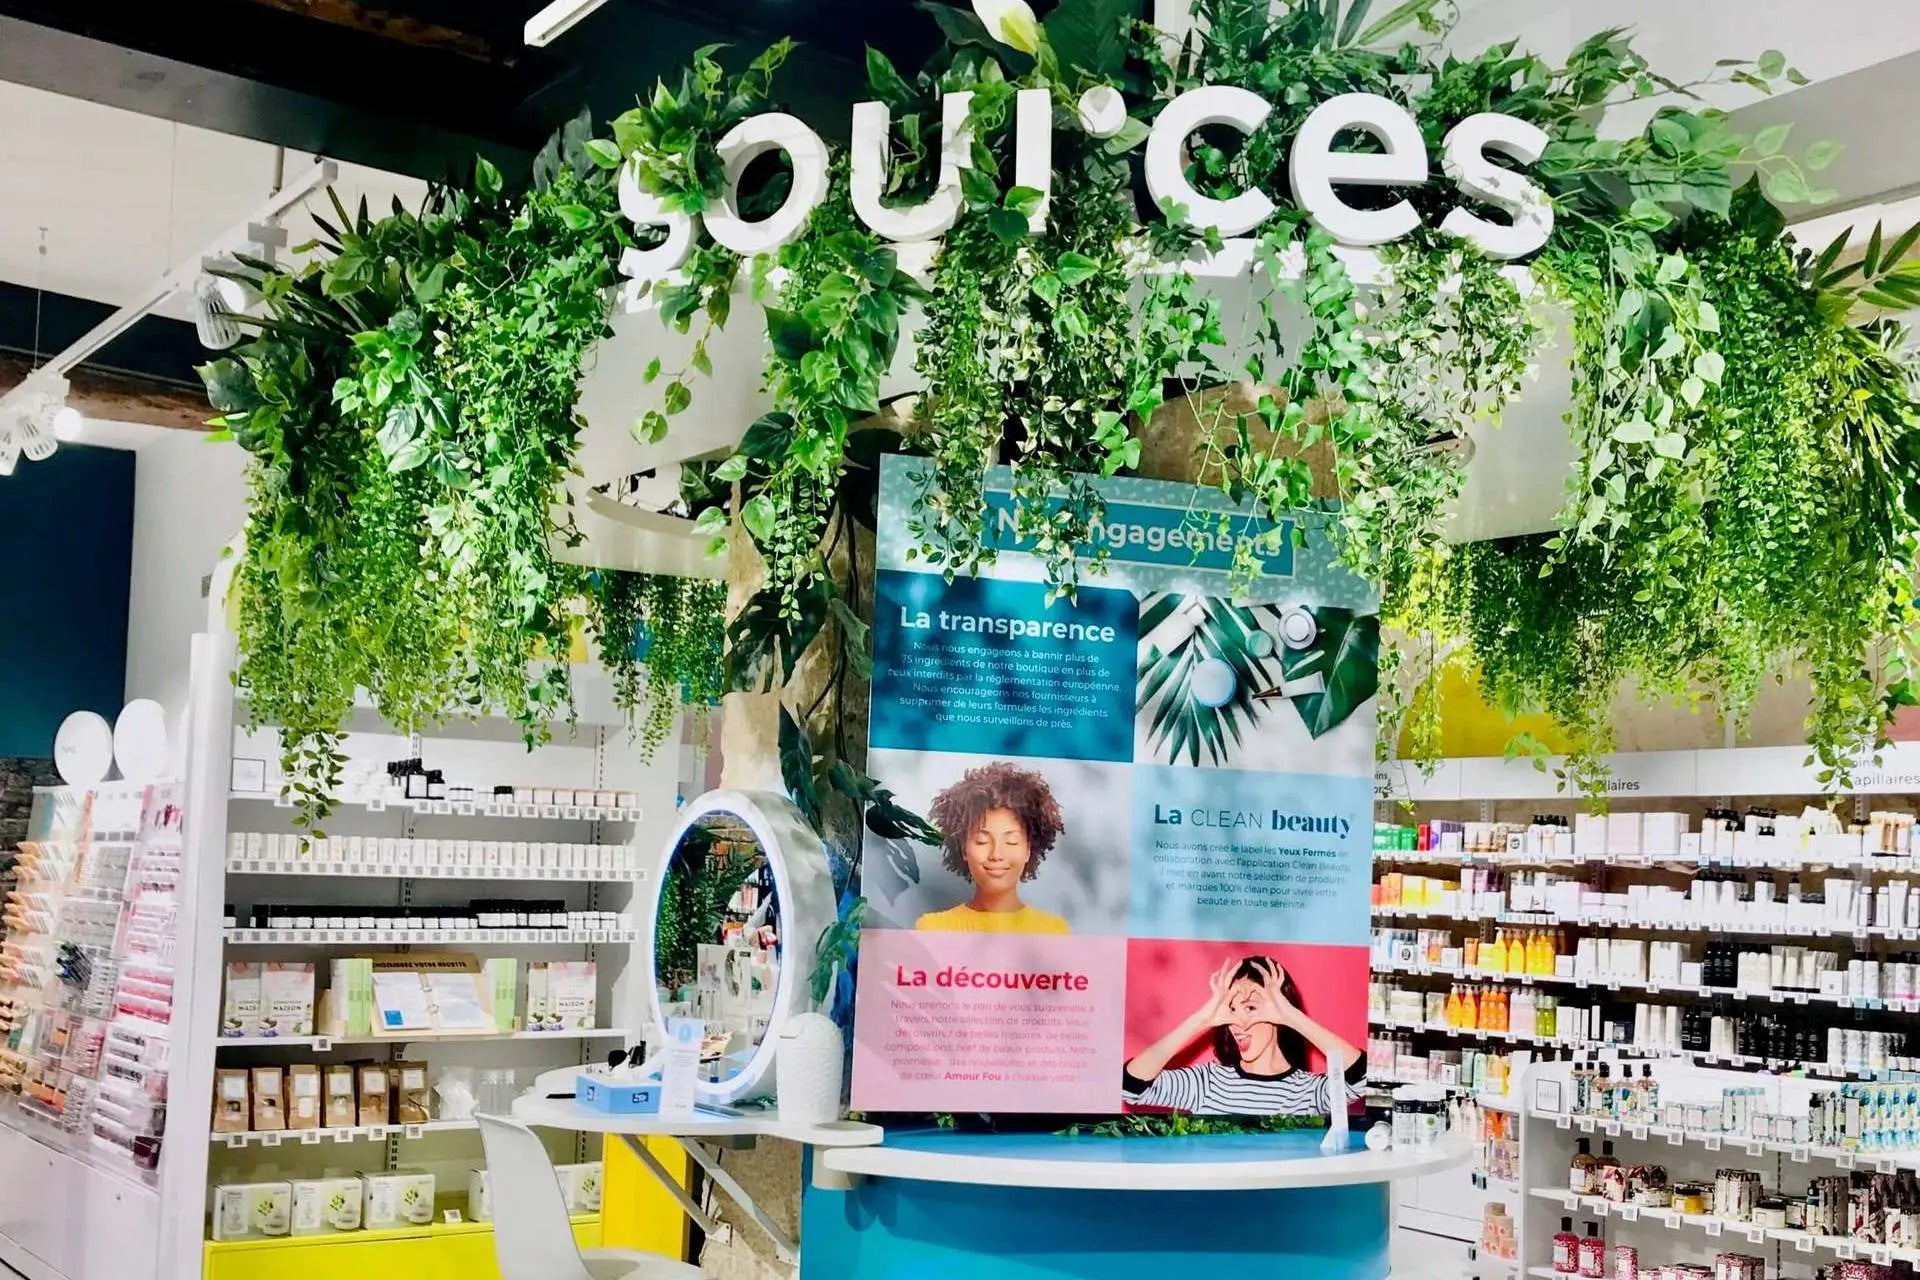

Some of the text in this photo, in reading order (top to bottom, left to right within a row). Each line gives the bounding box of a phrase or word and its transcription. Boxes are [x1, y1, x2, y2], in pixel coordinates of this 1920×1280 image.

[1086, 518, 1281, 556] ngagements
[901, 606, 1115, 643] La transparence
[941, 643, 966, 654] nous
[967, 646, 1022, 659] engageons
[1032, 650, 1063, 662] bannir
[1065, 653, 1086, 664] plus
[1087, 653, 1100, 664] de
[913, 669, 955, 680] interdits
[975, 673, 984, 682] la
[973, 659, 986, 669] de
[988, 661, 1014, 672] notre
[1016, 662, 1060, 676] boutique
[1061, 667, 1074, 676] en
[1076, 667, 1097, 679] plus
[1098, 668, 1111, 678] de
[913, 683, 939, 693] Nous
[941, 686, 1010, 698] encourageons
[1012, 690, 1030, 699] nos
[1031, 690, 1090, 704] fournisseurs
[953, 699, 967, 709] de
[968, 699, 993, 711] leurs
[994, 702, 1039, 713] formules
[935, 713, 956, 724] que
[957, 713, 982, 723] nous
[983, 716, 1034, 727] surveillons
[1035, 717, 1049, 728] de
[1154, 803, 1350, 840] La CLEAN beauty
[1155, 840, 1180, 850] Nous
[1278, 846, 1301, 857] Yeux
[1291, 860, 1318, 870] Clean
[1200, 871, 1226, 880] avant
[1228, 871, 1253, 881] notre
[1230, 898, 1243, 907] en
[897, 965, 1089, 991] La découverte
[943, 1071, 980, 1081] Amour
[982, 1072, 1003, 1082] Fou
